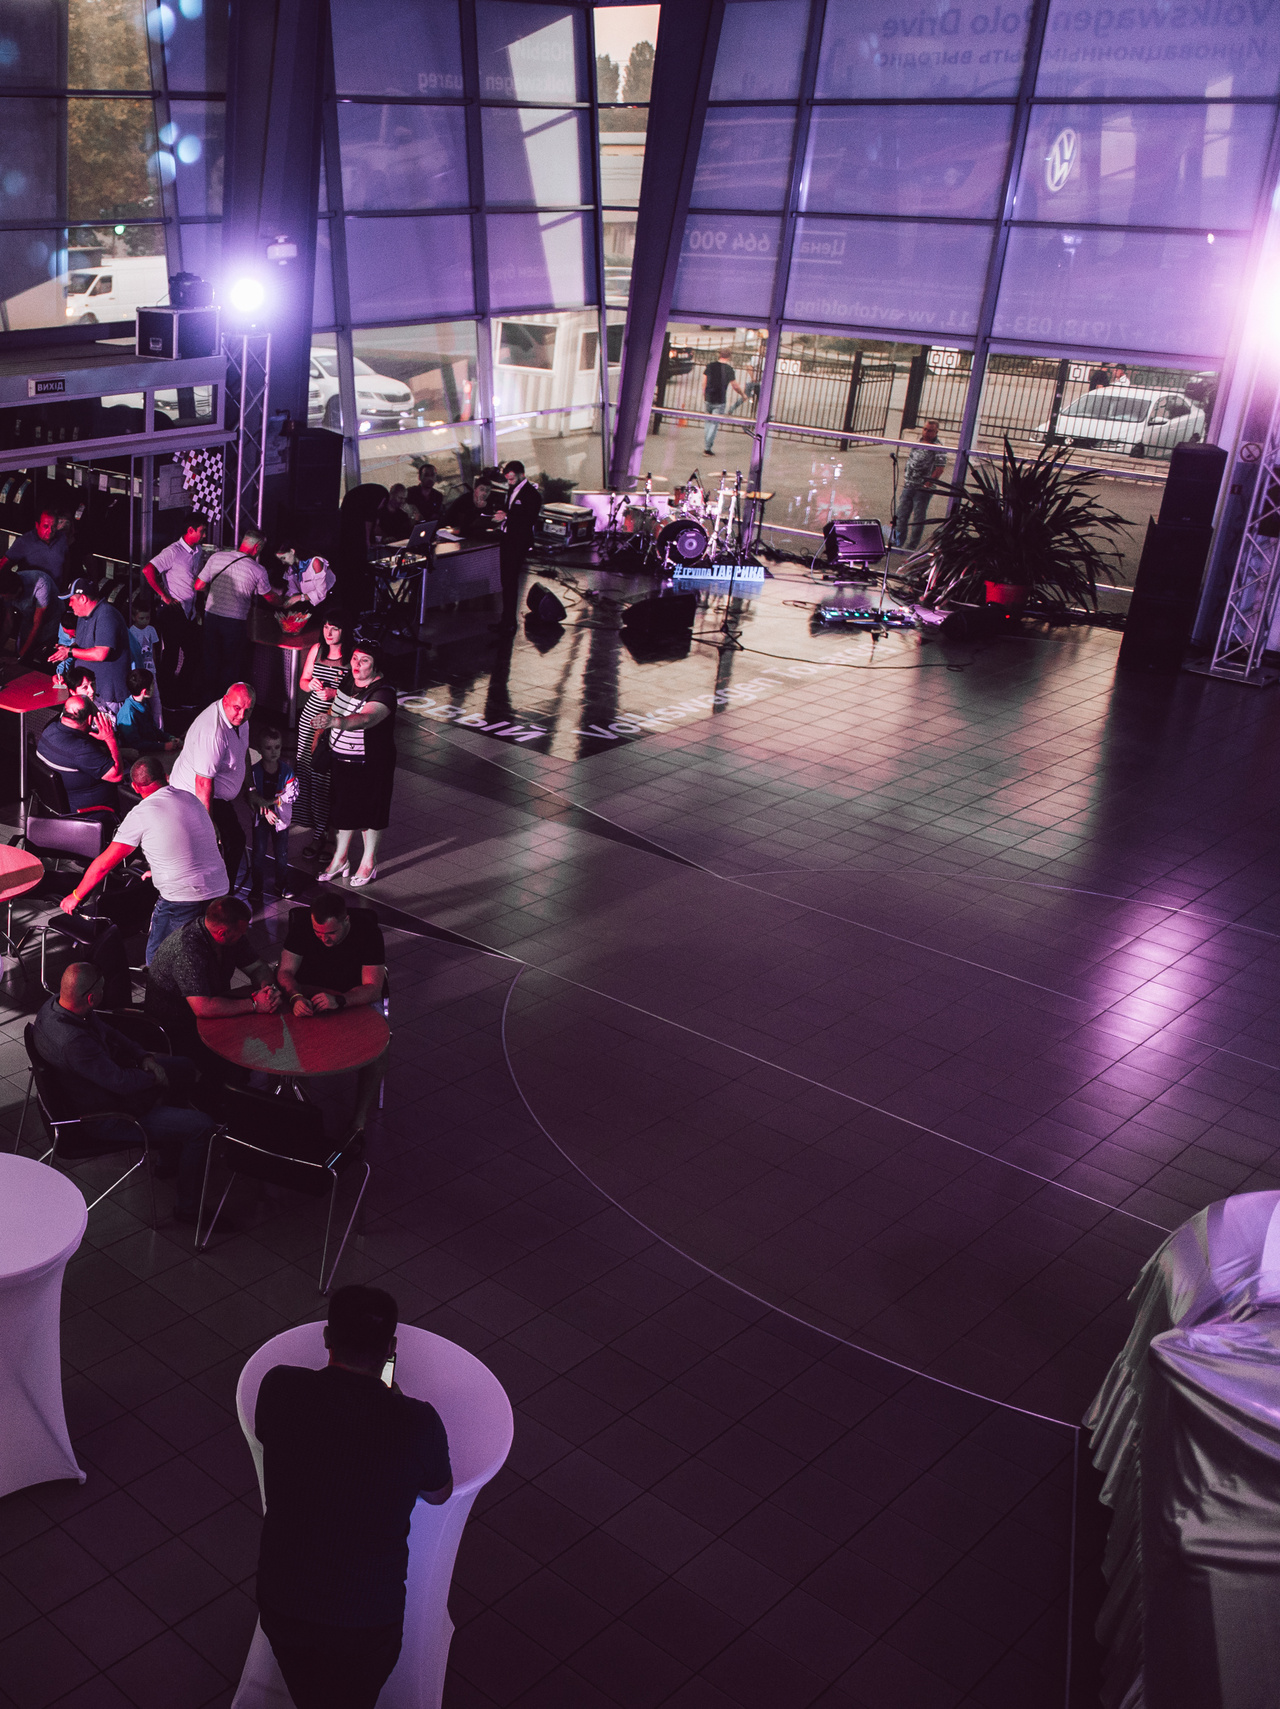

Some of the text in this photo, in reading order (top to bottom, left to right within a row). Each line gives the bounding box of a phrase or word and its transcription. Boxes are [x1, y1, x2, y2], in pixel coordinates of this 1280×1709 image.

[37, 382, 64, 391] ВИХІД
[396, 690, 548, 742] ОВЫЙ
[572, 677, 784, 740] Volkswagen
